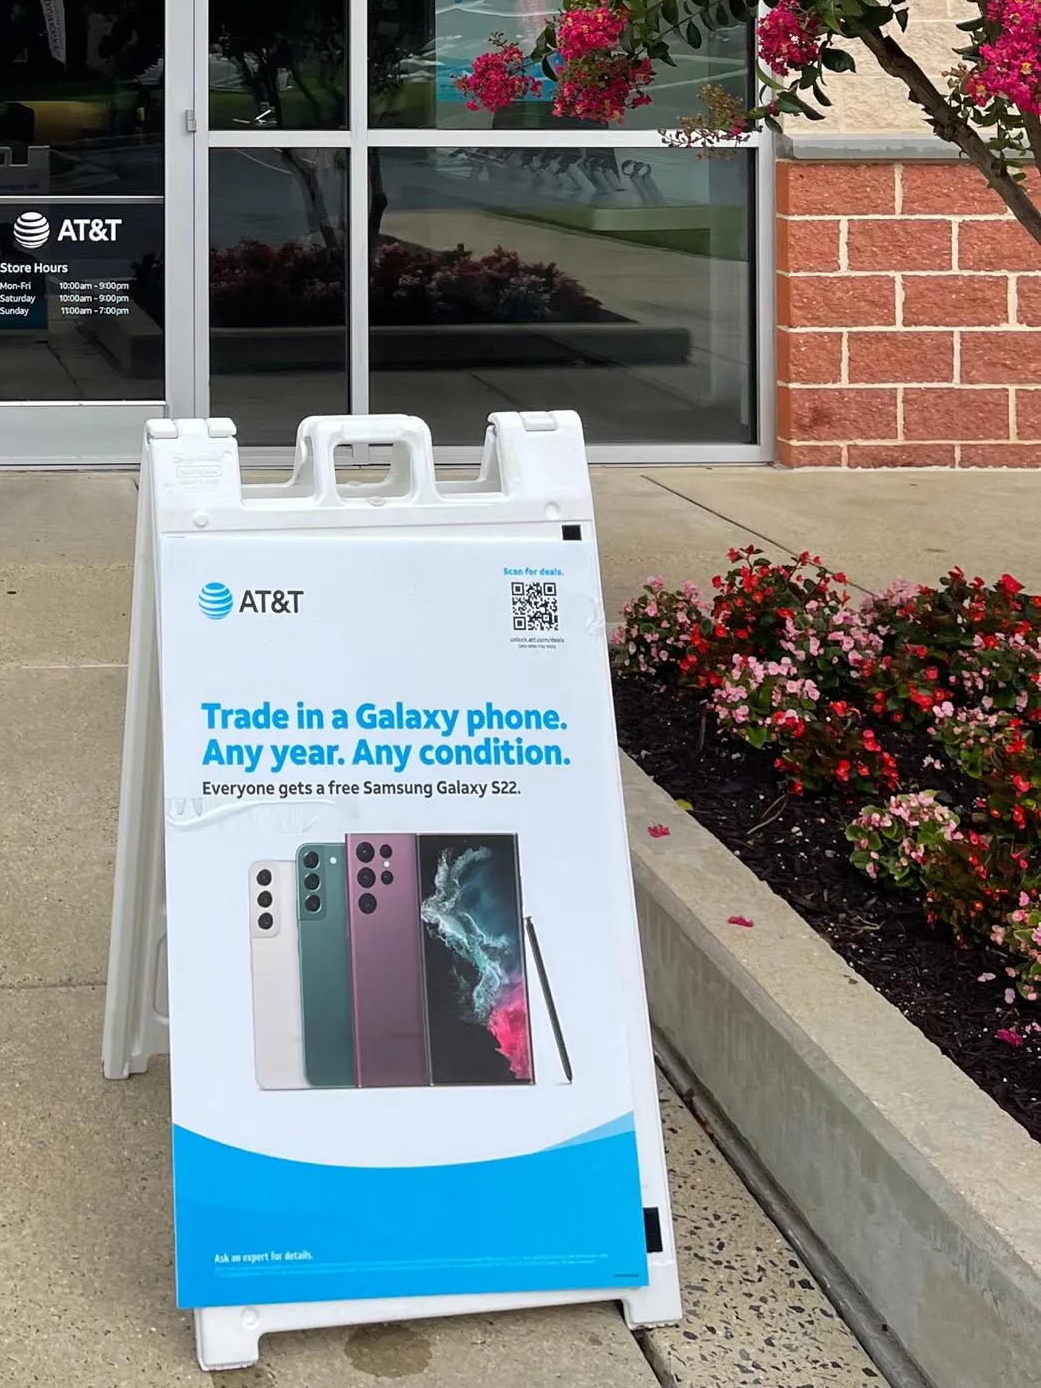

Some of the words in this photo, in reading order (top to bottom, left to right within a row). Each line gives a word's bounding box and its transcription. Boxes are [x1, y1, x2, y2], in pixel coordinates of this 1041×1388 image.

[57, 219, 122, 242] AT&T
[0, 263, 32, 273] Store
[34, 263, 69, 273] Hours
[0, 282, 31, 290] Mon-Fri
[59, 282, 92, 290] 10:00am
[99, 282, 129, 291] 9:00pm
[0, 294, 36, 304] Saturday
[59, 294, 92, 302] 10:00am
[99, 294, 129, 303] 9:00pm
[0, 306, 29, 316] Sunday
[61, 307, 92, 315] 11:00am
[99, 307, 129, 316] 7:00pm
[539, 568, 564, 576] deals.
[239, 589, 304, 614] AT&T
[201, 702, 289, 729] Trade
[297, 701, 324, 729] in
[332, 708, 348, 729] a
[356, 702, 459, 737] Galaxy
[467, 702, 567, 737] phone.
[202, 739, 263, 773] Any
[270, 744, 345, 773] year.
[352, 739, 412, 773] Any
[419, 737, 571, 765] condition.
[202, 781, 275, 798] Everyone
[279, 782, 312, 798] gets
[316, 784, 325, 795] a
[328, 780, 359, 795] free
[363, 781, 432, 798] Samsung
[436, 780, 487, 798] Galaxy
[491, 780, 521, 795] S22.
[214, 1253, 229, 1263] Ask
[243, 1253, 269, 1264] expert
[271, 1251, 282, 1261] for
[284, 1250, 313, 1261] details.
